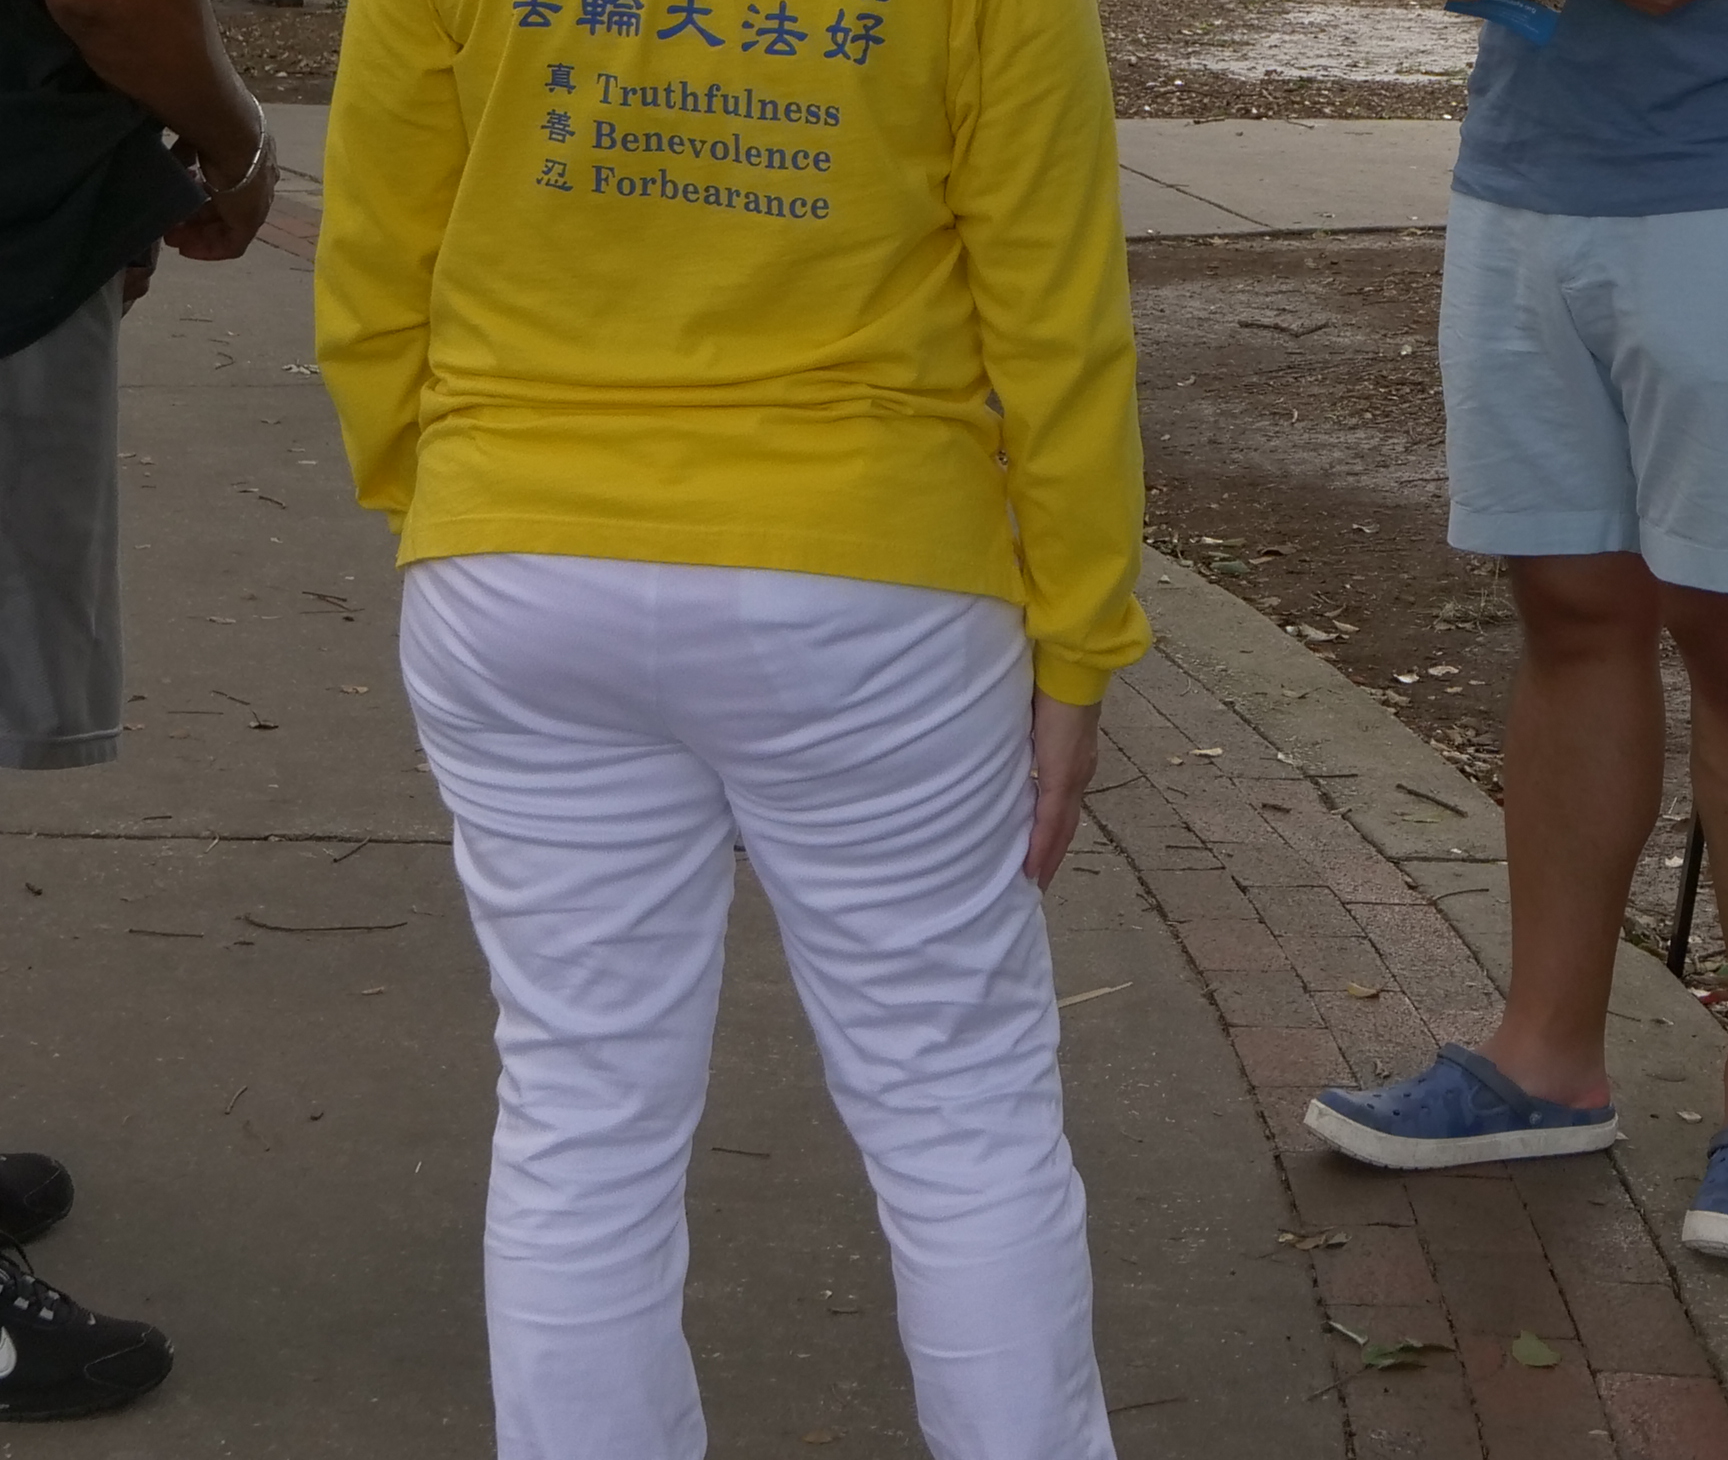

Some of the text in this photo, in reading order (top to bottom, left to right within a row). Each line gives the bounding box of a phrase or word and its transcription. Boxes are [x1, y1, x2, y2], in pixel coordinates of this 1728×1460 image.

[597, 73, 841, 128] Truthfulness
[591, 119, 832, 172] Benevolence
[591, 164, 830, 221] Forbearance
